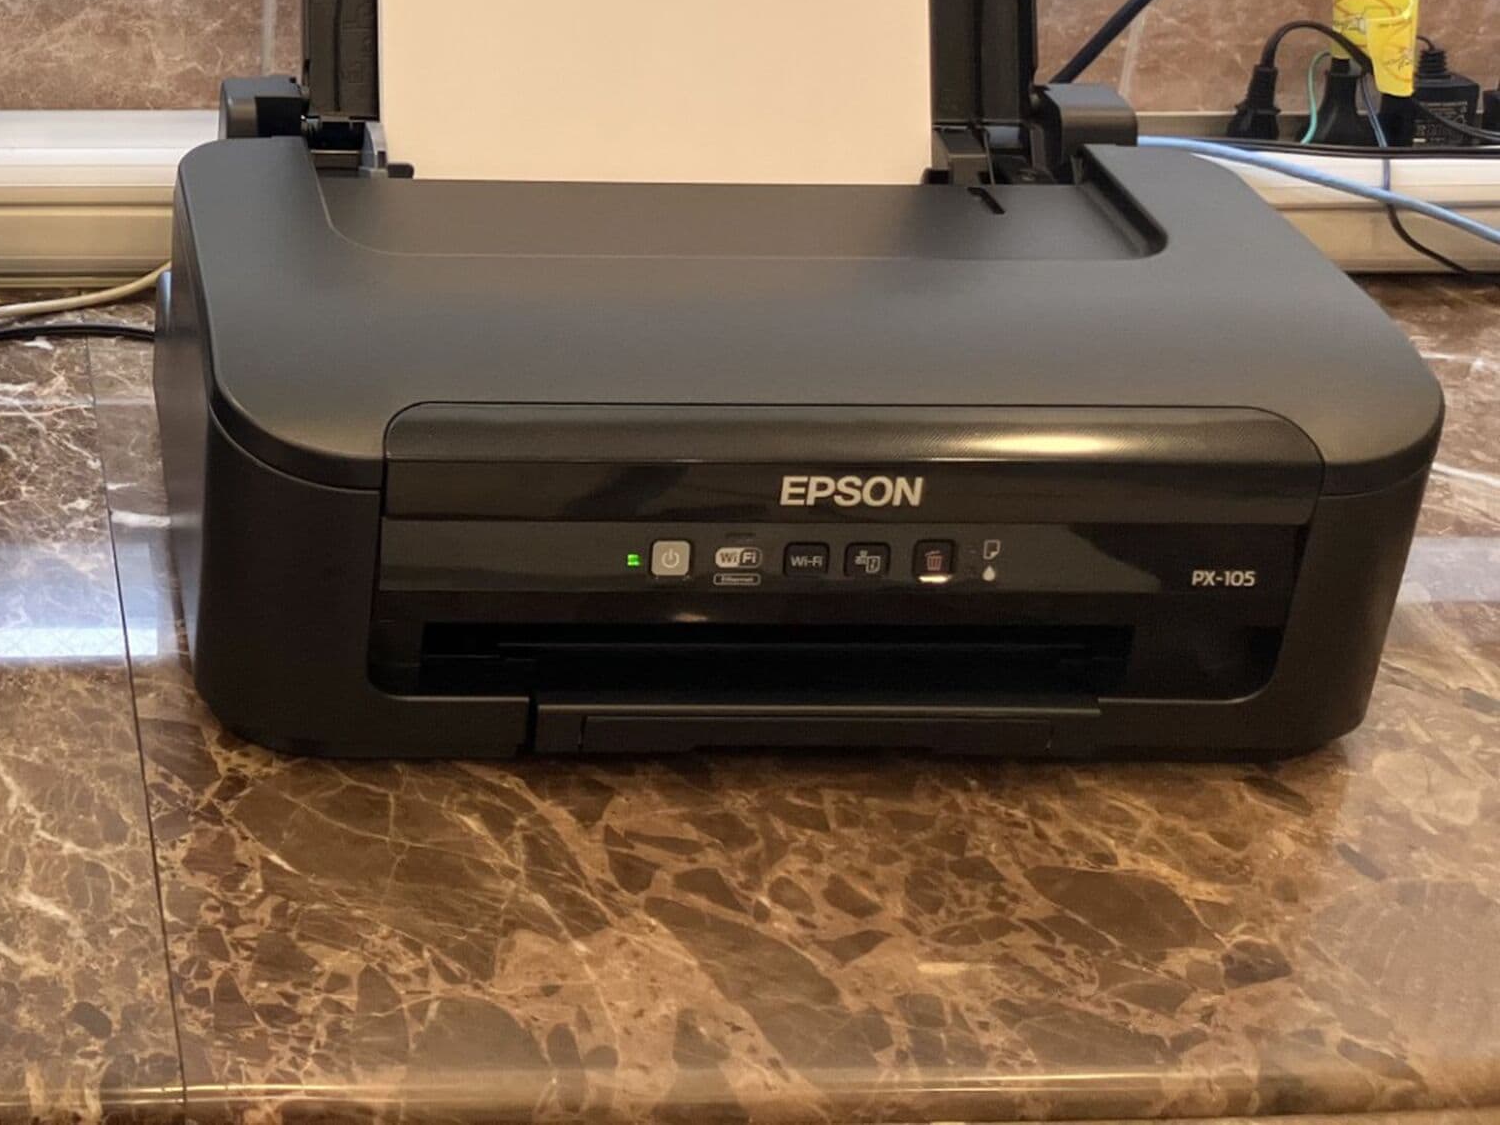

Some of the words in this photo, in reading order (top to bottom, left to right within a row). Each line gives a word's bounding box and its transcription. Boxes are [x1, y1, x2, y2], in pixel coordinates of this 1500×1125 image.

[779, 475, 924, 506] EPSON
[790, 554, 824, 567] Wi-Fi
[1190, 569, 1257, 587] PX-105
